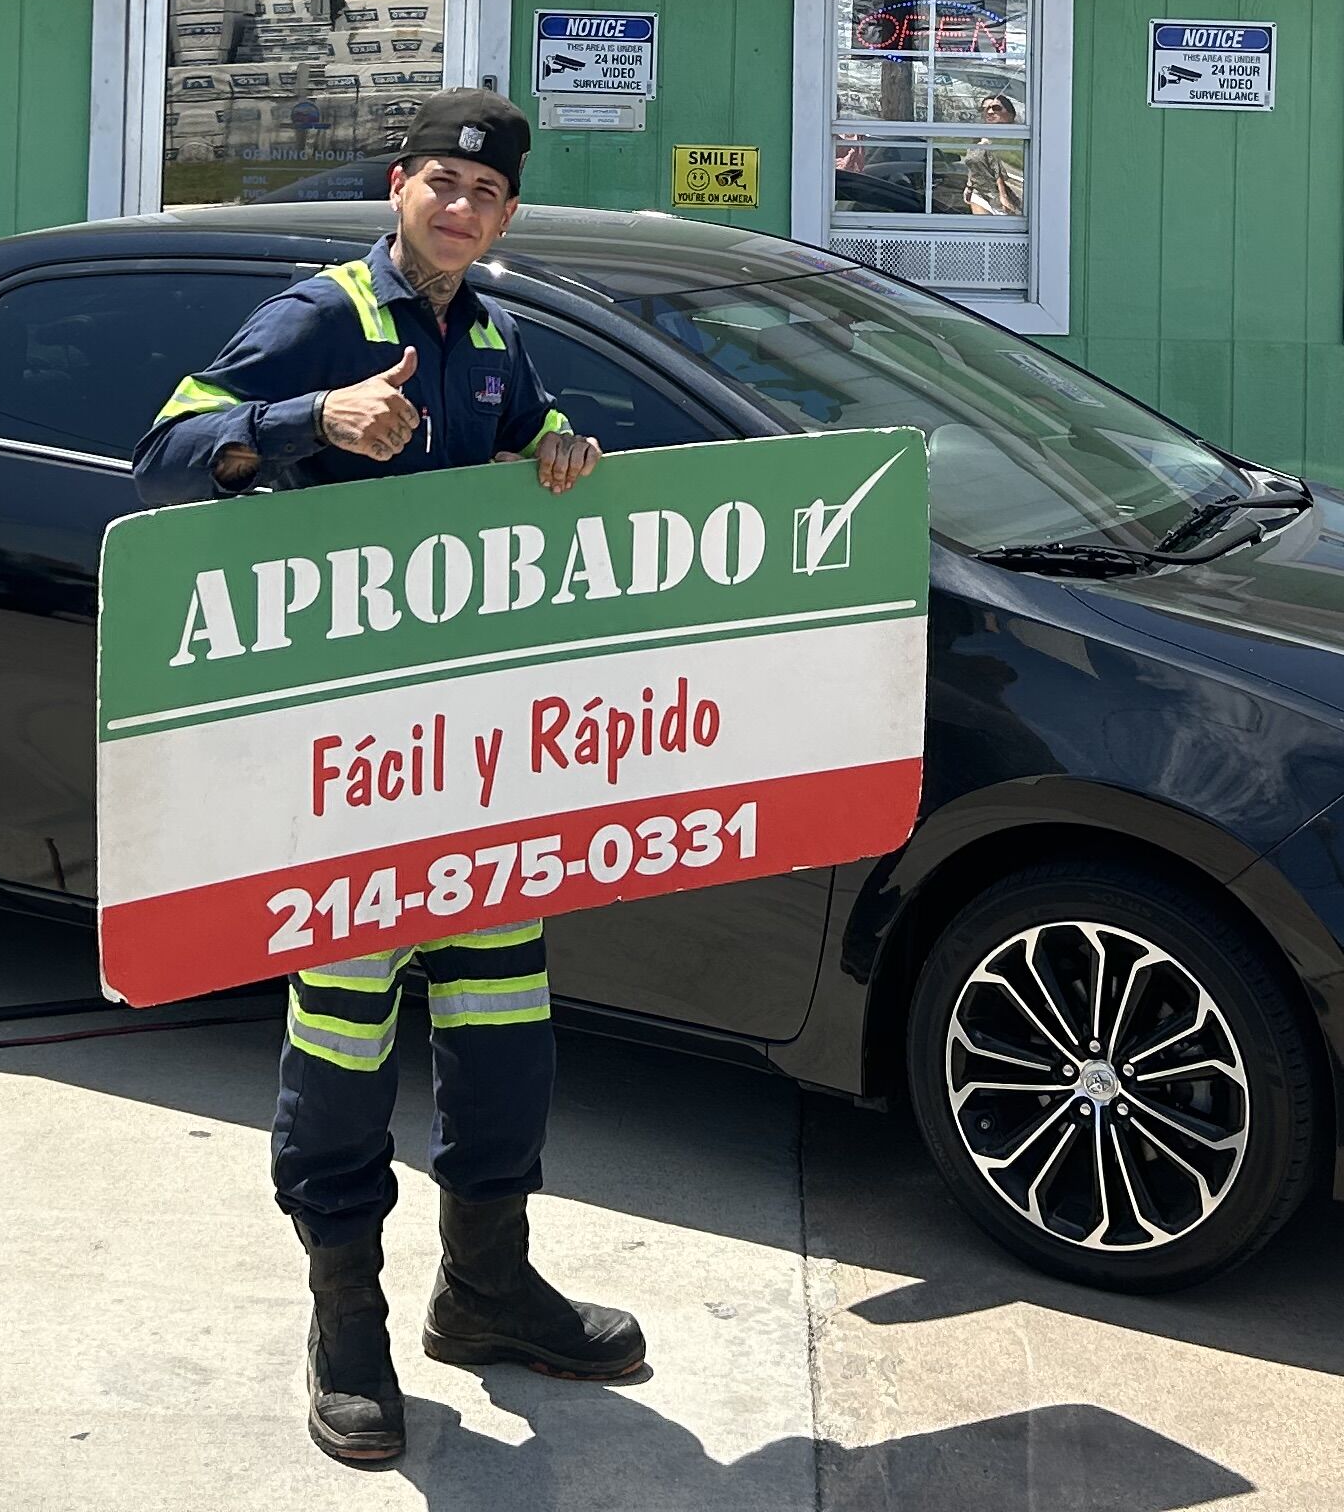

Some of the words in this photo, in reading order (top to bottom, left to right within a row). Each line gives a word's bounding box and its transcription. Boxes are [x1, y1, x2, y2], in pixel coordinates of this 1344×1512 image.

[565, 18, 627, 37] NOTICE
[1182, 28, 1245, 48] NOTICE
[567, 43, 584, 52] THIS
[585, 43, 606, 52] AREA
[607, 44, 615, 53] IS
[617, 44, 643, 53] UNDER
[594, 54, 608, 65] 24
[611, 54, 643, 66] HOUR
[1182, 53, 1201, 62] THIS
[1201, 54, 1223, 63] AREA
[1224, 55, 1233, 64] IS
[1234, 55, 1261, 64] UNDER
[601, 67, 636, 79] VIDEO
[1211, 64, 1225, 76] 24
[1228, 65, 1261, 77] HOUR
[572, 79, 642, 90] SURVEILLANCE
[1218, 78, 1253, 90] VIDEO
[1189, 90, 1260, 102] SURVEILLANCE
[315, 150, 366, 162] HOURS
[688, 150, 745, 167] SMILE!
[677, 192, 706, 202] YOU'RE
[707, 193, 720, 203] ON
[722, 193, 754, 204] CAMERA
[168, 499, 766, 669] APROBADO
[311, 714, 446, 817] Fácil
[474, 728, 502, 808] y
[531, 676, 720, 785] Rápido
[265, 801, 759, 956] 214-875-0331
